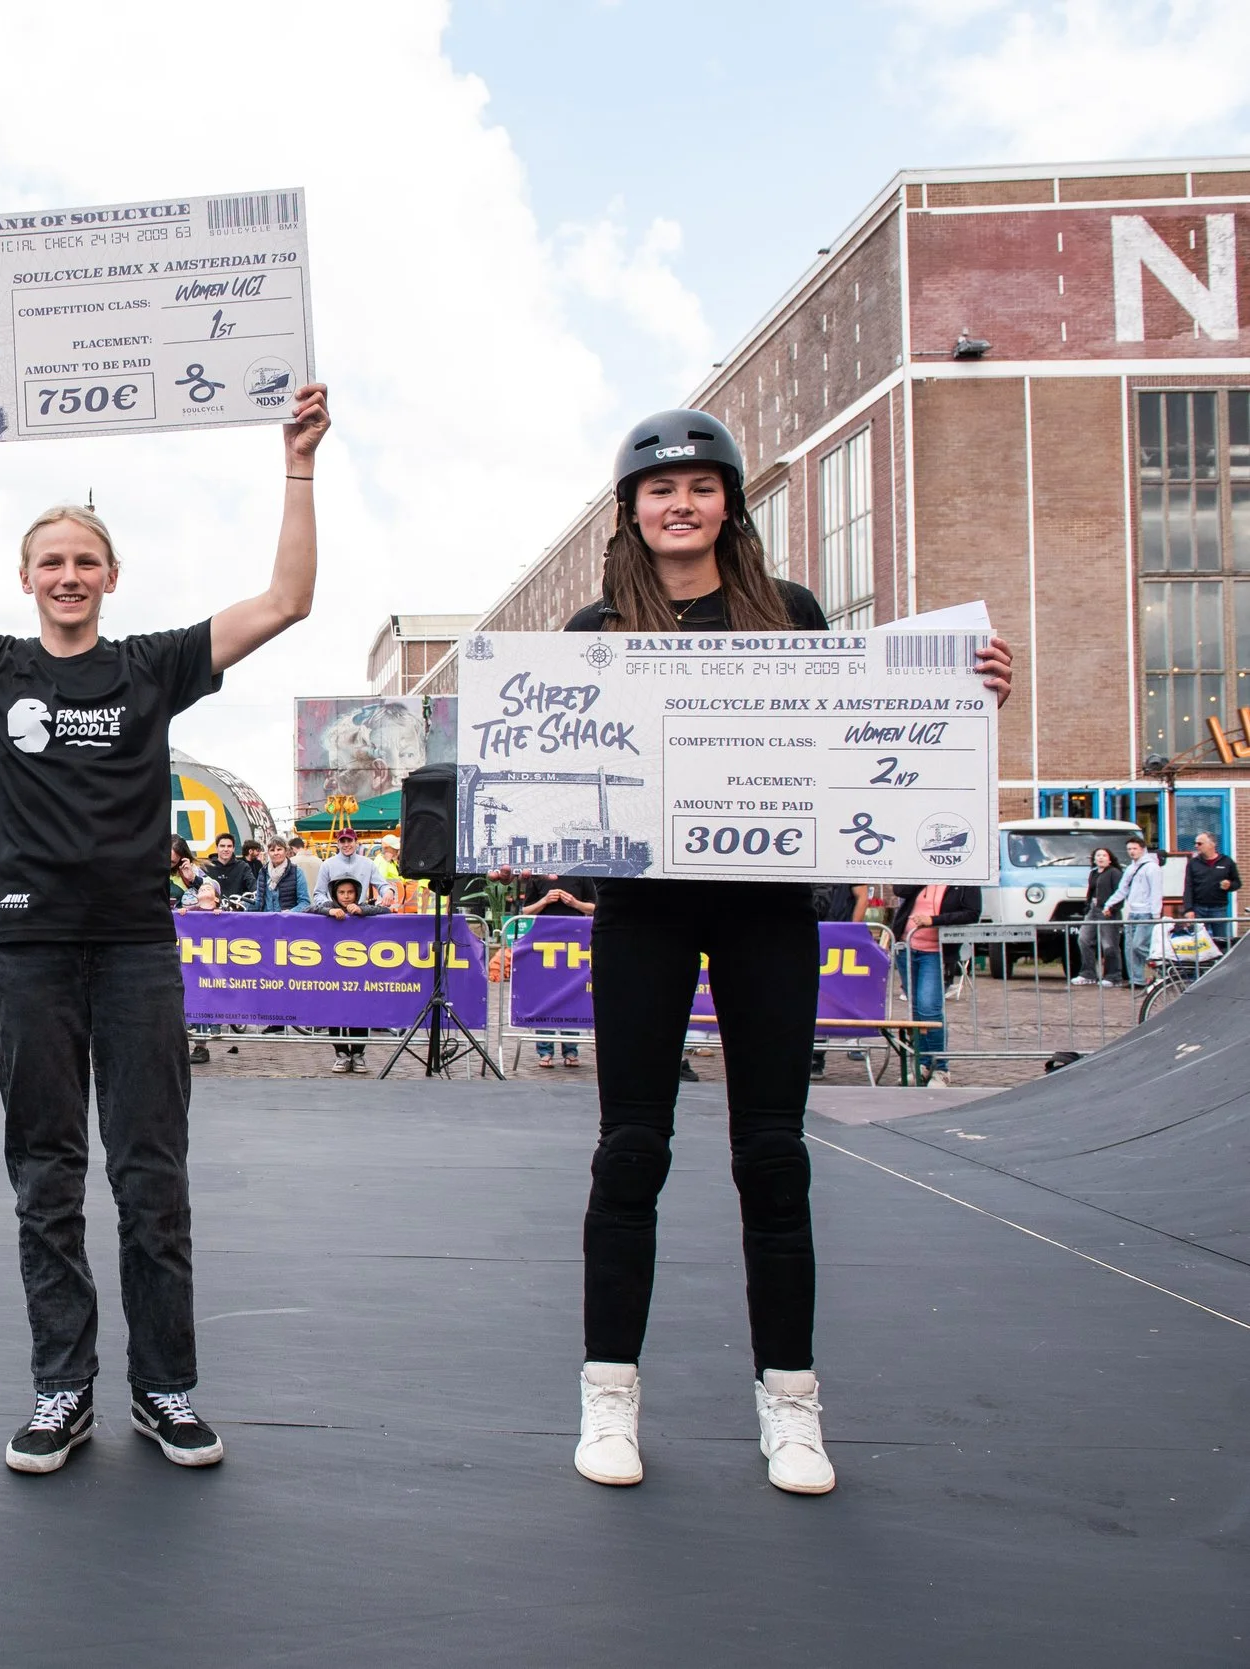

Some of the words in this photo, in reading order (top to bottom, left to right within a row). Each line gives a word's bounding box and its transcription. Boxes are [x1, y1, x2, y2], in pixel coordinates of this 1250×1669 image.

[40, 213, 67, 227] OF
[69, 203, 190, 225] SOULCYCLE
[44, 234, 84, 250] CHECK
[136, 227, 168, 242] 2009
[174, 225, 191, 239] 63
[208, 224, 271, 237] SOULCYCLE
[278, 222, 298, 230] BMX
[12, 266, 103, 284] SOULCYCLE
[106, 263, 144, 277] BMX
[147, 262, 159, 274] X
[163, 253, 267, 272] AMSTERDAM
[270, 251, 297, 263] 750
[1111, 213, 1239, 342] N
[174, 278, 229, 302] WOMEN
[230, 273, 267, 298] UCI
[17, 302, 104, 317] COMPETITION
[107, 298, 151, 311] CLASS:
[209, 308, 237, 340] 1ST
[72, 334, 152, 350] PLACEMENT:
[24, 362, 79, 375] AMOUNT
[81, 361, 99, 371] TO
[102, 359, 119, 370] BE
[122, 357, 151, 368] PAID
[38, 383, 138, 415] 750€
[255, 395, 285, 406] NDSM
[181, 404, 224, 414] SOULCYCLE
[624, 638, 693, 651] BANK
[697, 638, 727, 650] OF
[730, 636, 866, 650] SOULCYCLE
[625, 661, 692, 675] OFFICIAL
[700, 661, 744, 675] CHECK
[804, 661, 840, 675] 2009
[847, 660, 866, 675] 64
[886, 666, 957, 675] SOULCYCLE
[499, 671, 601, 717] SHRED
[664, 698, 765, 710] SOULCYCLE
[768, 698, 811, 710] BMX
[814, 698, 829, 710] X
[832, 698, 950, 710] AMSTERDAM
[955, 699, 984, 710] 750
[55, 721, 121, 738] DOODLE
[471, 719, 533, 760] THE
[537, 712, 641, 756] SHACK
[843, 720, 906, 745] WOMEN
[907, 721, 949, 745] UCI
[668, 736, 765, 747] COMPETITION
[768, 737, 816, 747] CLASS:
[507, 773, 560, 781] N.D.S.M.
[869, 756, 919, 787] 2ND
[726, 775, 816, 786] PLACEMENT:
[672, 799, 733, 810] AMOUNT
[736, 800, 756, 810] TO
[759, 800, 778, 810] BE
[781, 800, 813, 811] PAID
[684, 826, 803, 856] 300€
[845, 858, 893, 866] SOULCYCLE
[928, 854, 962, 865] NDSM
[177, 937, 262, 965] HIS
[275, 938, 323, 966] IS
[333, 940, 470, 969] SOUL
[198, 976, 227, 989] INLINE
[228, 977, 257, 990] SKATE
[288, 979, 340, 991] OVERTOOM
[364, 980, 421, 993] AMSTERDAM
